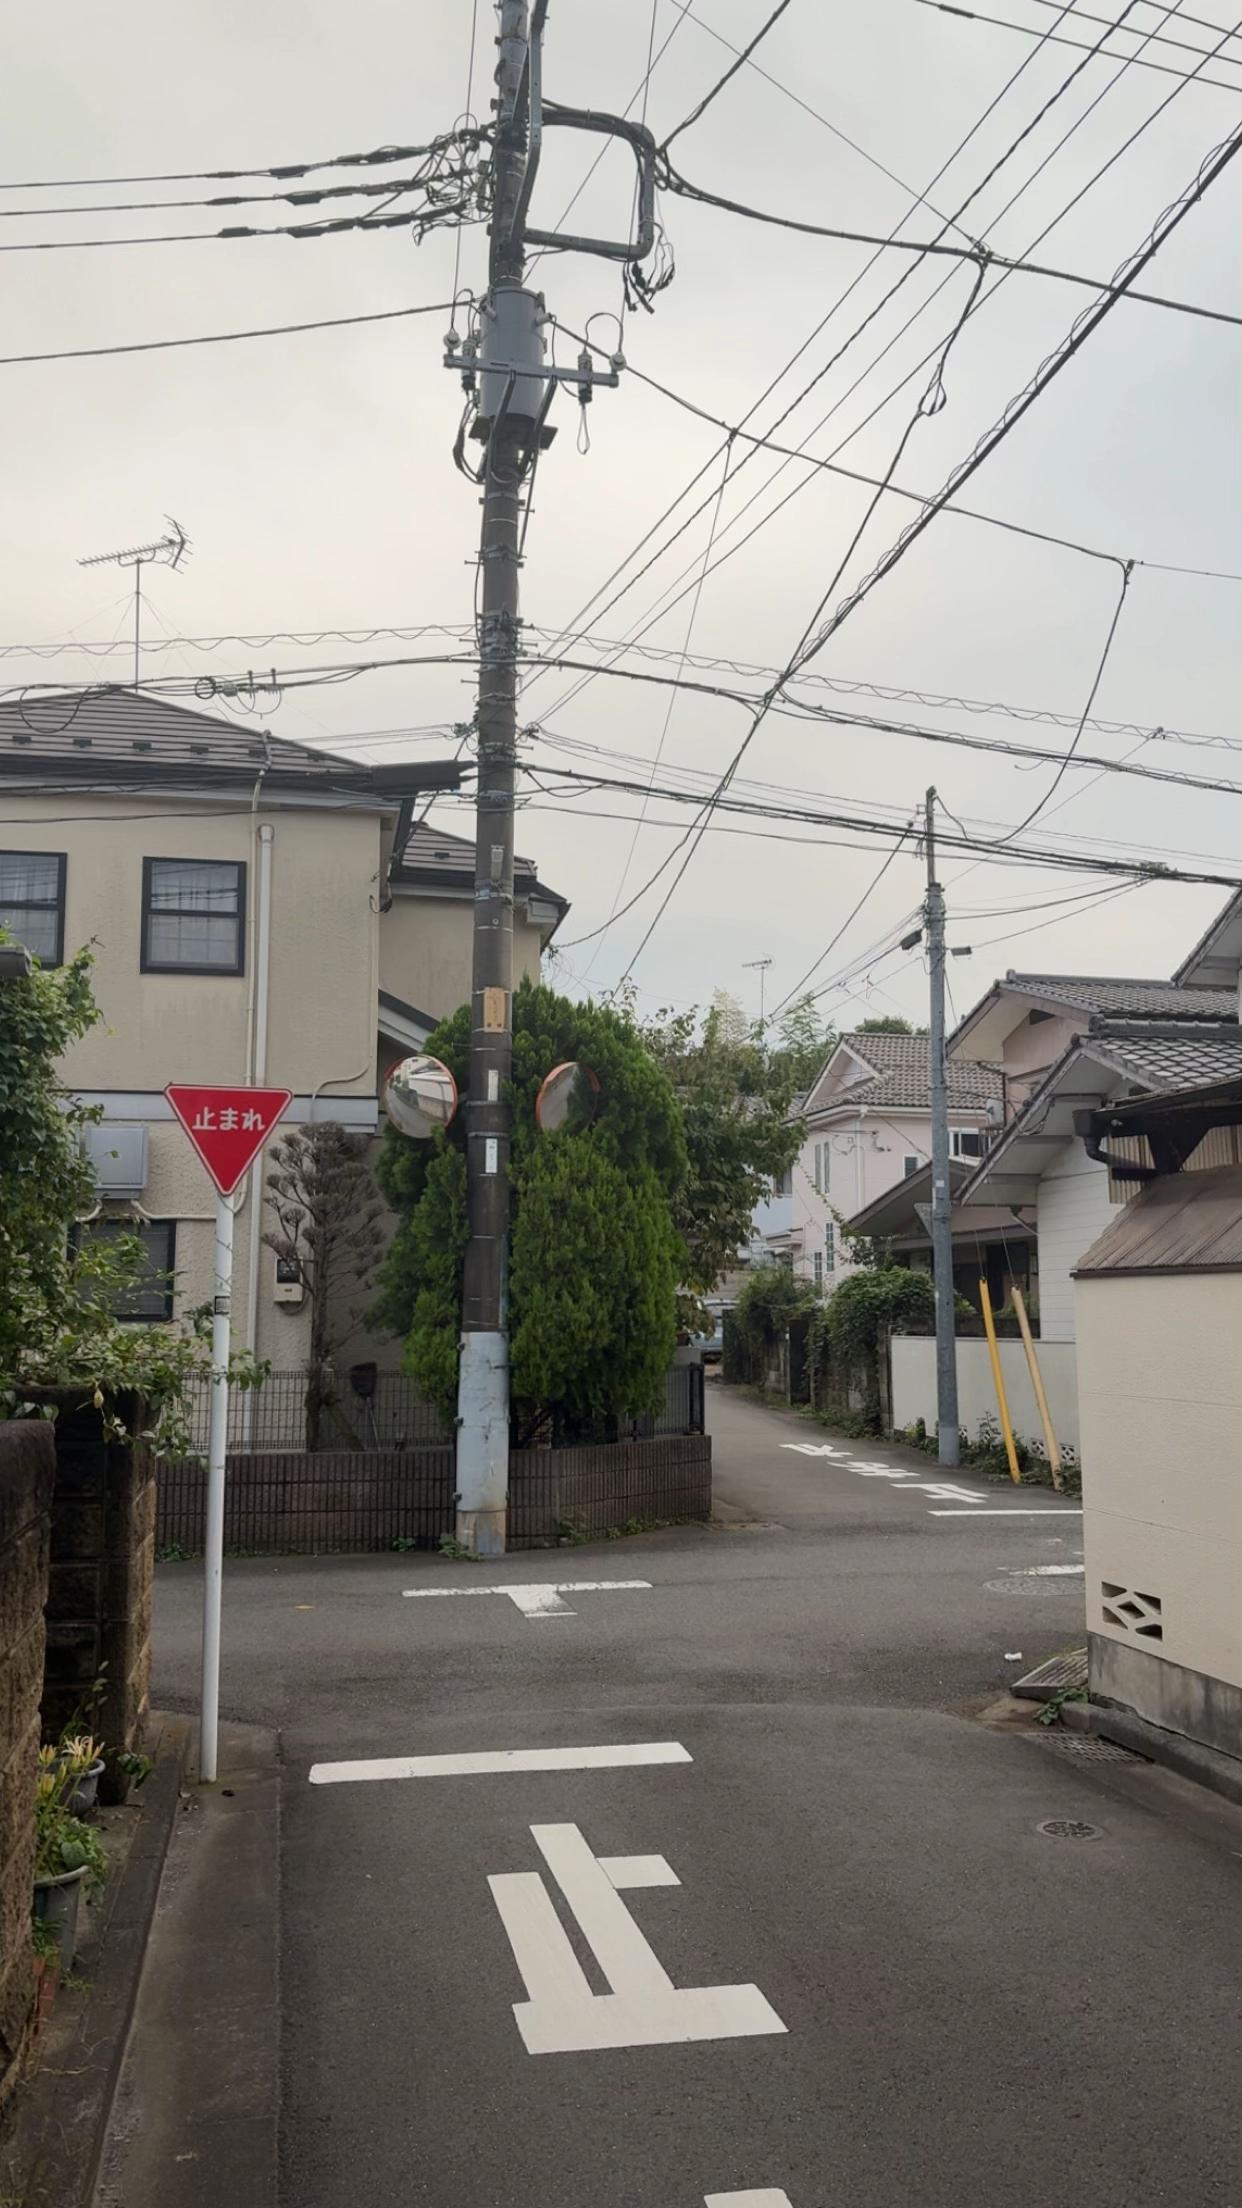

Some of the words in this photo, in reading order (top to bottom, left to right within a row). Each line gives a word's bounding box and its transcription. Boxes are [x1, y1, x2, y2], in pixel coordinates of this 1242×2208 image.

[192, 1106, 265, 1131] 止まれ
[779, 1443, 989, 1503] 止まれ
